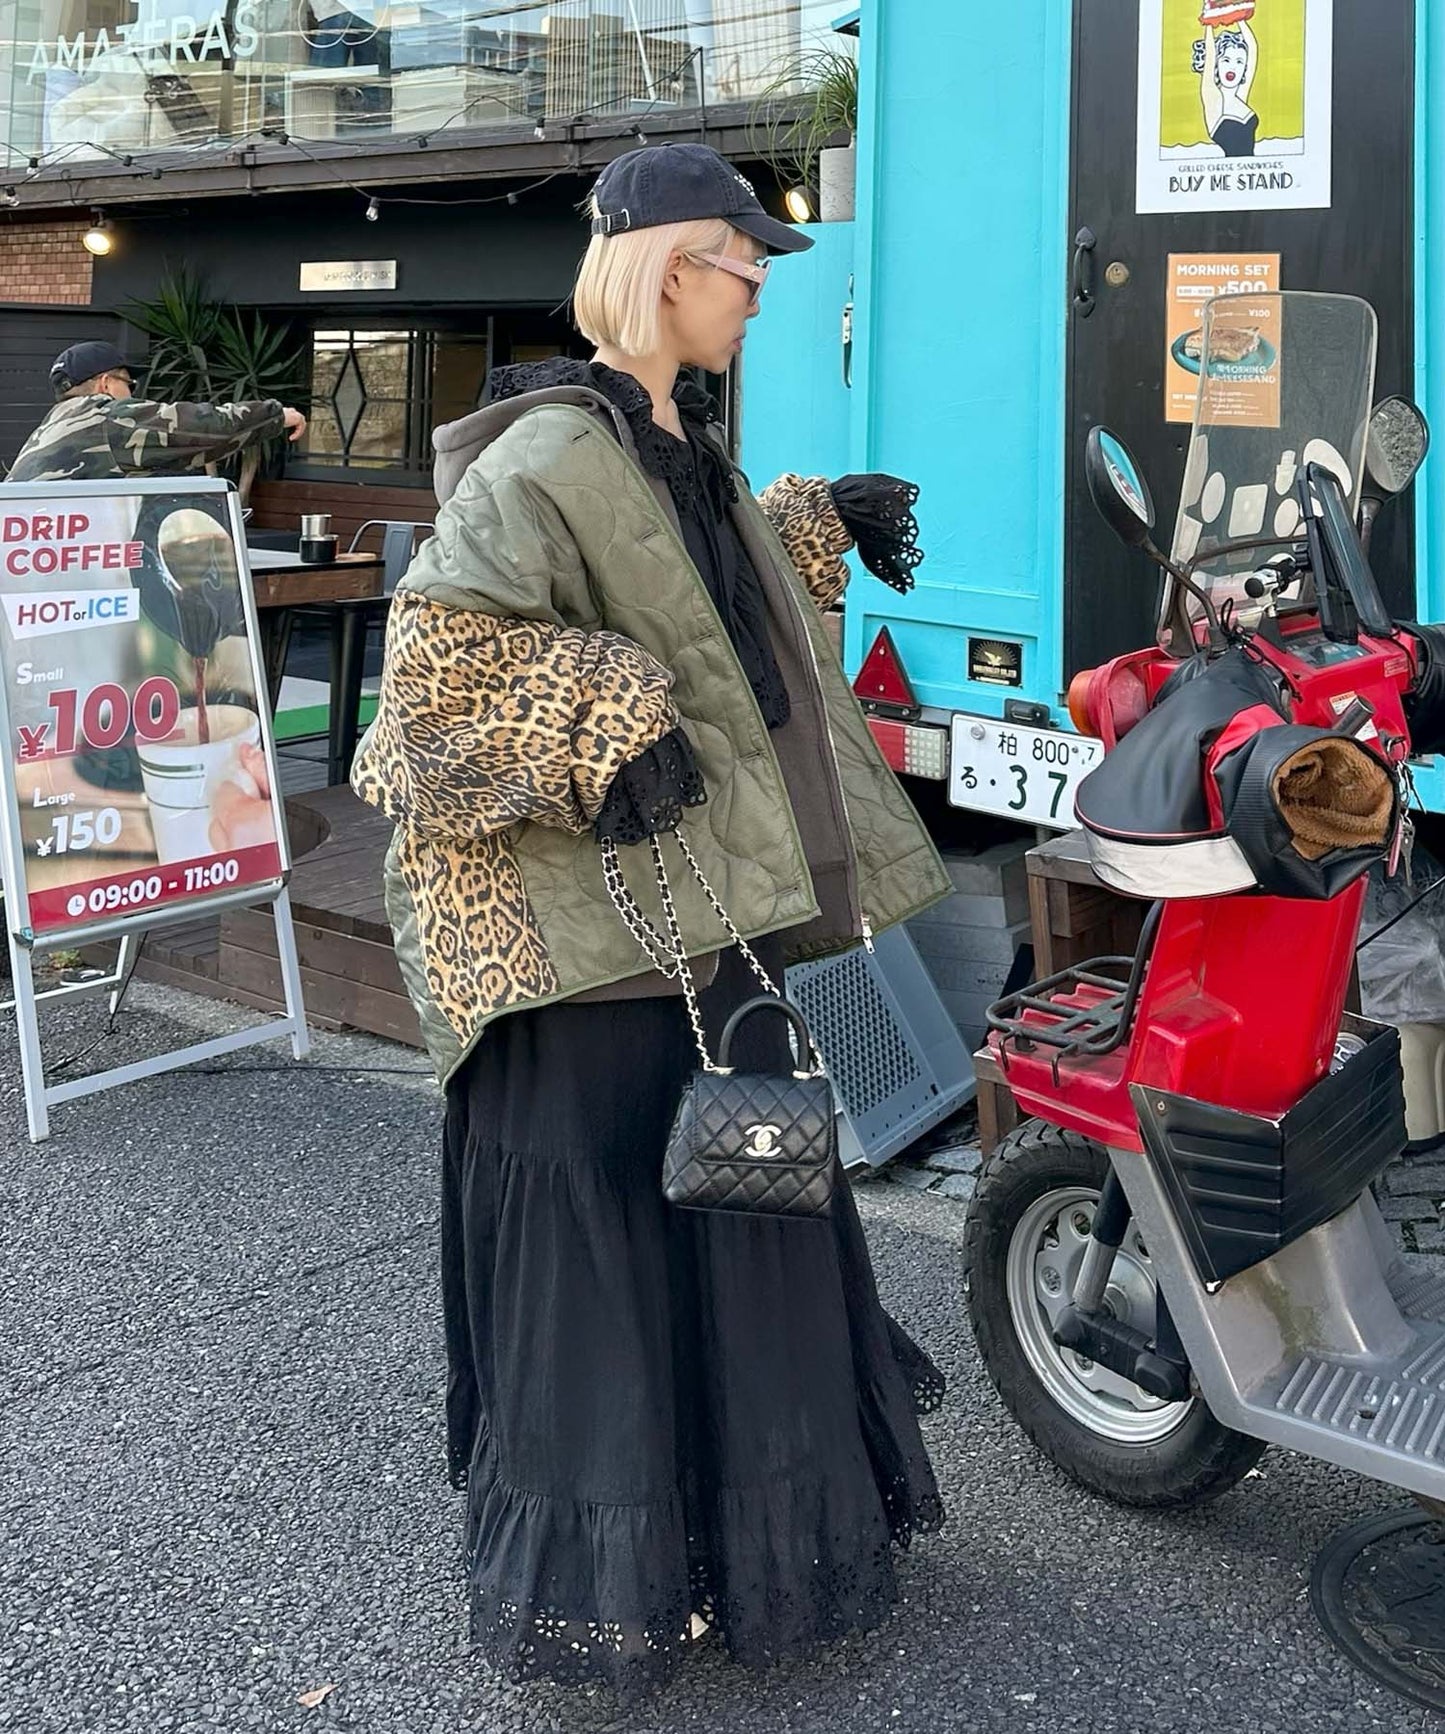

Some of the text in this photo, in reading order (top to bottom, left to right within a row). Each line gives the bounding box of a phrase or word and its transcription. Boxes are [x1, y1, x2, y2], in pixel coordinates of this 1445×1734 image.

[26, 3, 259, 86] AMATERAS
[1207, 162, 1234, 172] CHEESE
[1237, 161, 1284, 171] SANDWICHES
[1169, 172, 1294, 193] BUY ME STAND
[1176, 264, 1271, 276] MORNING SET
[3, 514, 90, 543] DRIP
[6, 541, 144, 577] COFFEE
[18, 600, 76, 626] HOT
[88, 596, 128, 620] ICE
[16, 662, 63, 684] Small
[997, 731, 1070, 766] 柏 800
[33, 788, 76, 808] Large
[88, 875, 162, 911] 09:00
[184, 858, 240, 892] 11:00
